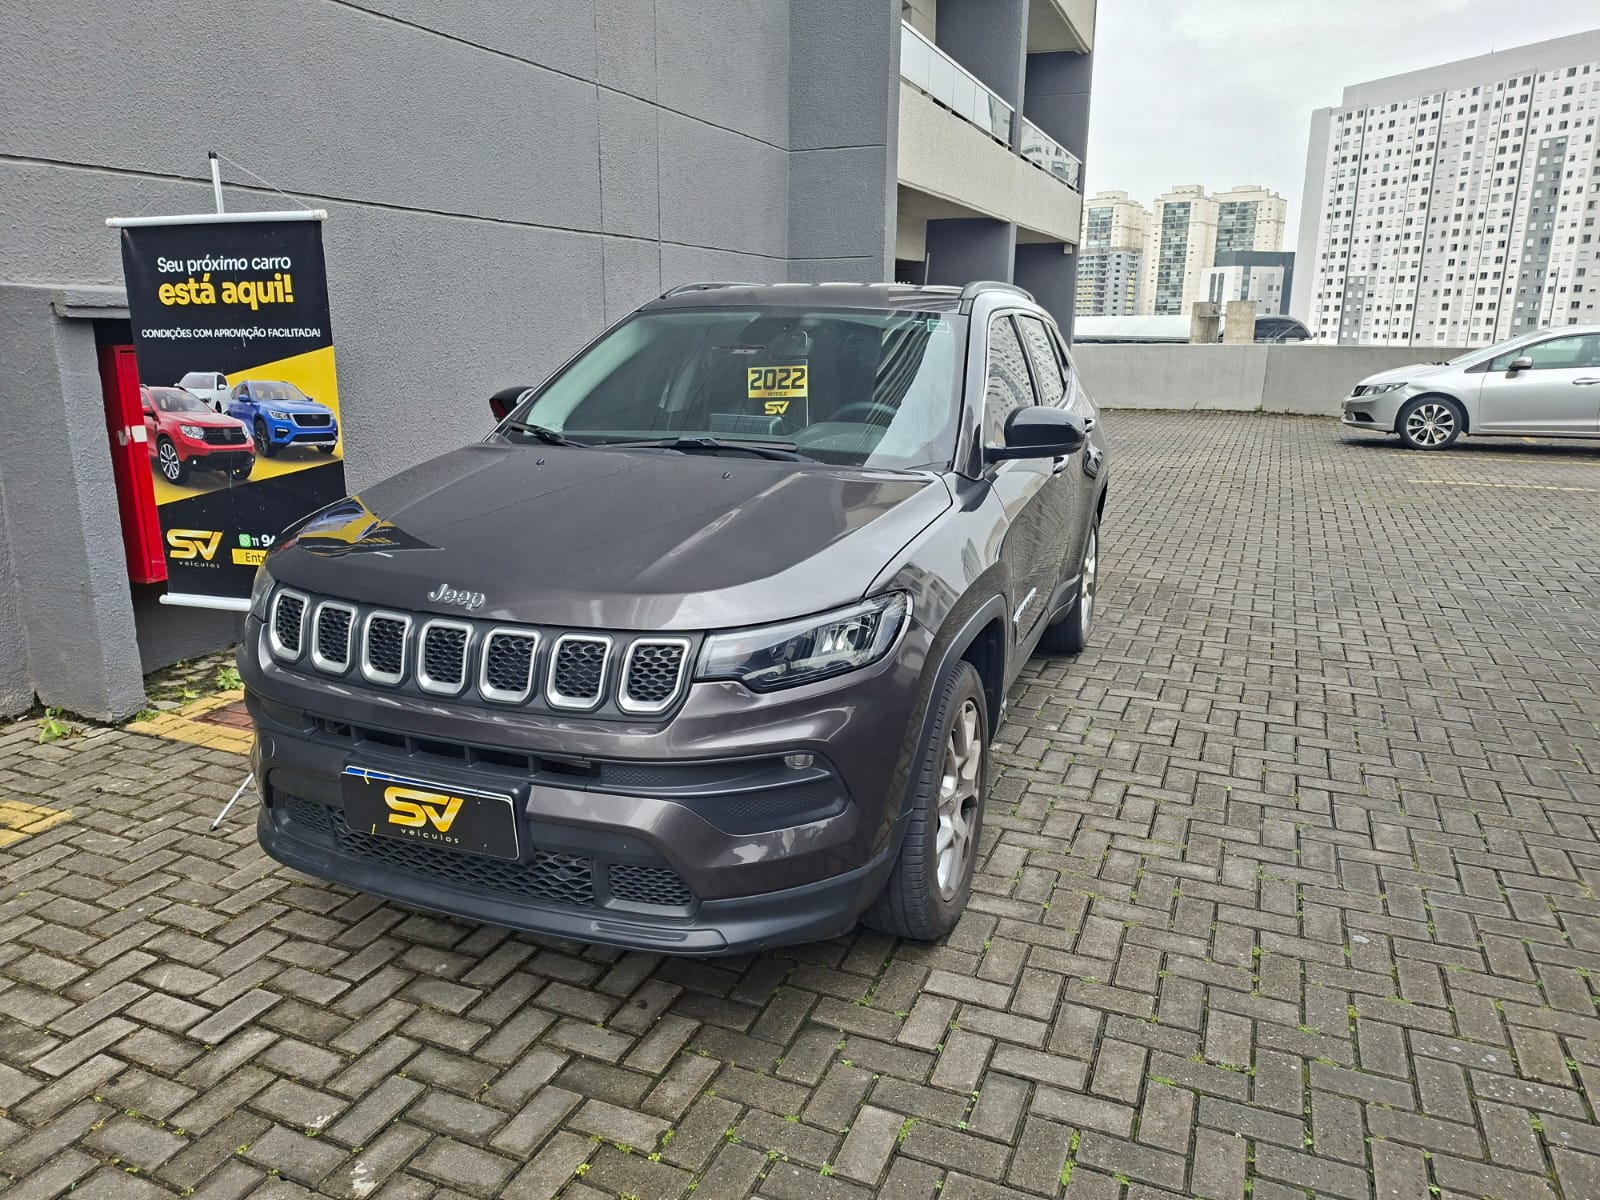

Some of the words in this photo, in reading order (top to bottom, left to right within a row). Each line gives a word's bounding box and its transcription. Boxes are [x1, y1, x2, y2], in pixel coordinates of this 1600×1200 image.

[157, 257, 184, 273] Seu
[187, 254, 248, 275] próximo
[251, 256, 291, 271] carro
[158, 273, 217, 306] está
[221, 273, 295, 311] aqui!
[141, 326, 192, 341] CONDIÇÕES
[192, 328, 213, 338] COM
[213, 326, 267, 340] APROVAÇÃO
[267, 328, 321, 338] FACILITADA!
[750, 367, 806, 390] 2022
[764, 400, 790, 415] SV
[166, 528, 224, 561] SV
[427, 583, 487, 612] Jeep
[384, 786, 465, 833] SV
